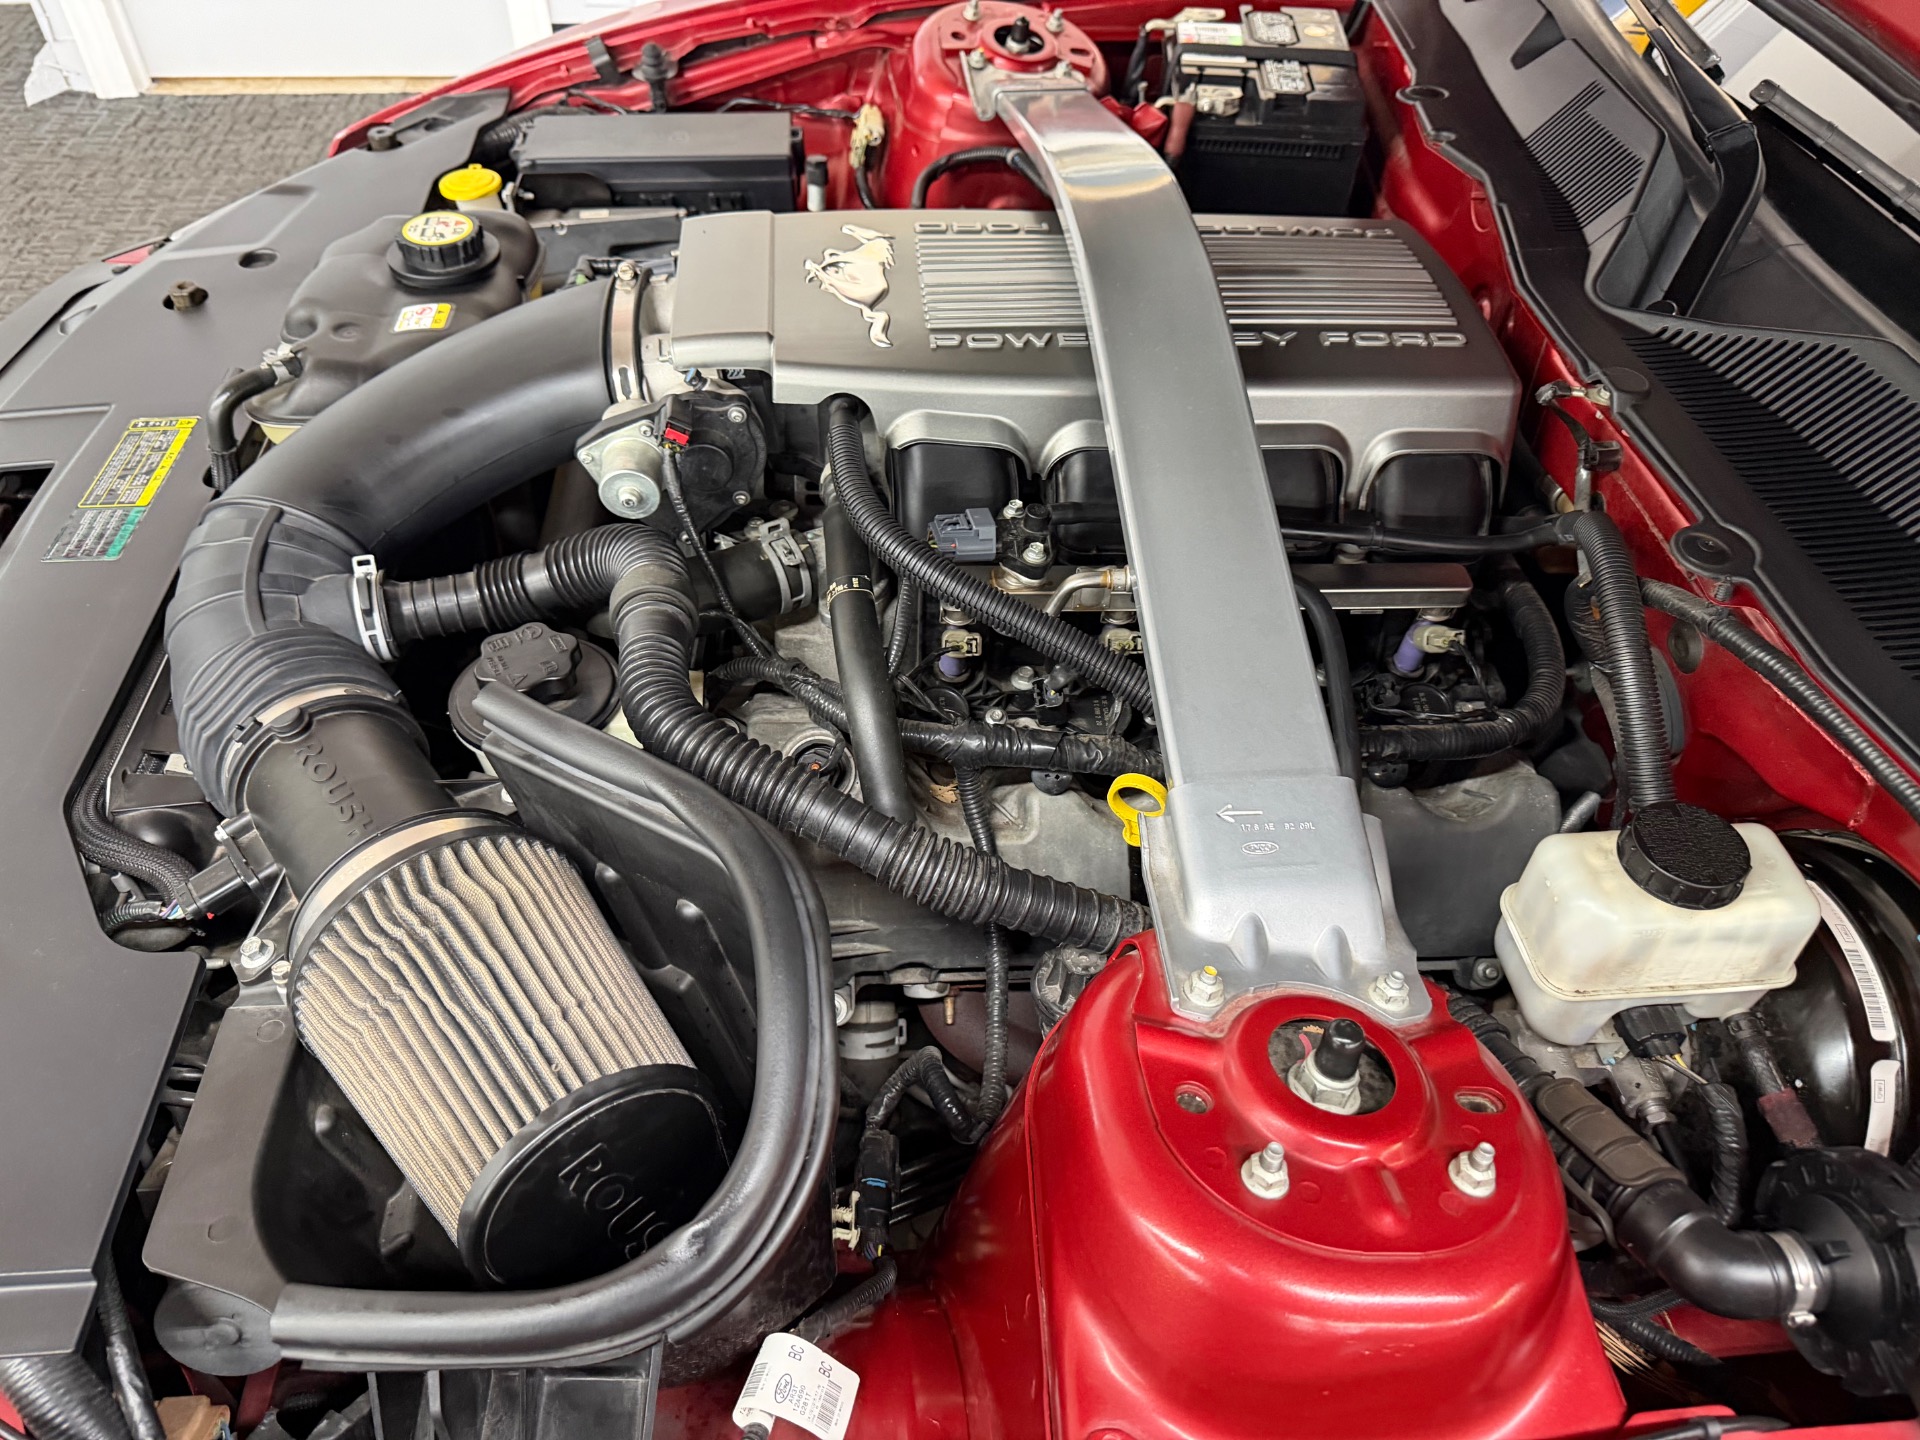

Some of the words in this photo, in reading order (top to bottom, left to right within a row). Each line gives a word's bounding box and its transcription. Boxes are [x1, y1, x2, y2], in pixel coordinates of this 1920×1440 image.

[914, 222, 1049, 234] FORD
[1198, 225, 1395, 239] POWERE
[928, 332, 1090, 349] POWE
[1318, 330, 1467, 347] FORD
[557, 1142, 669, 1261] ROUS
[788, 1344, 805, 1361] BC
[818, 1361, 833, 1378] BC
[776, 1377, 791, 1401] Ford
